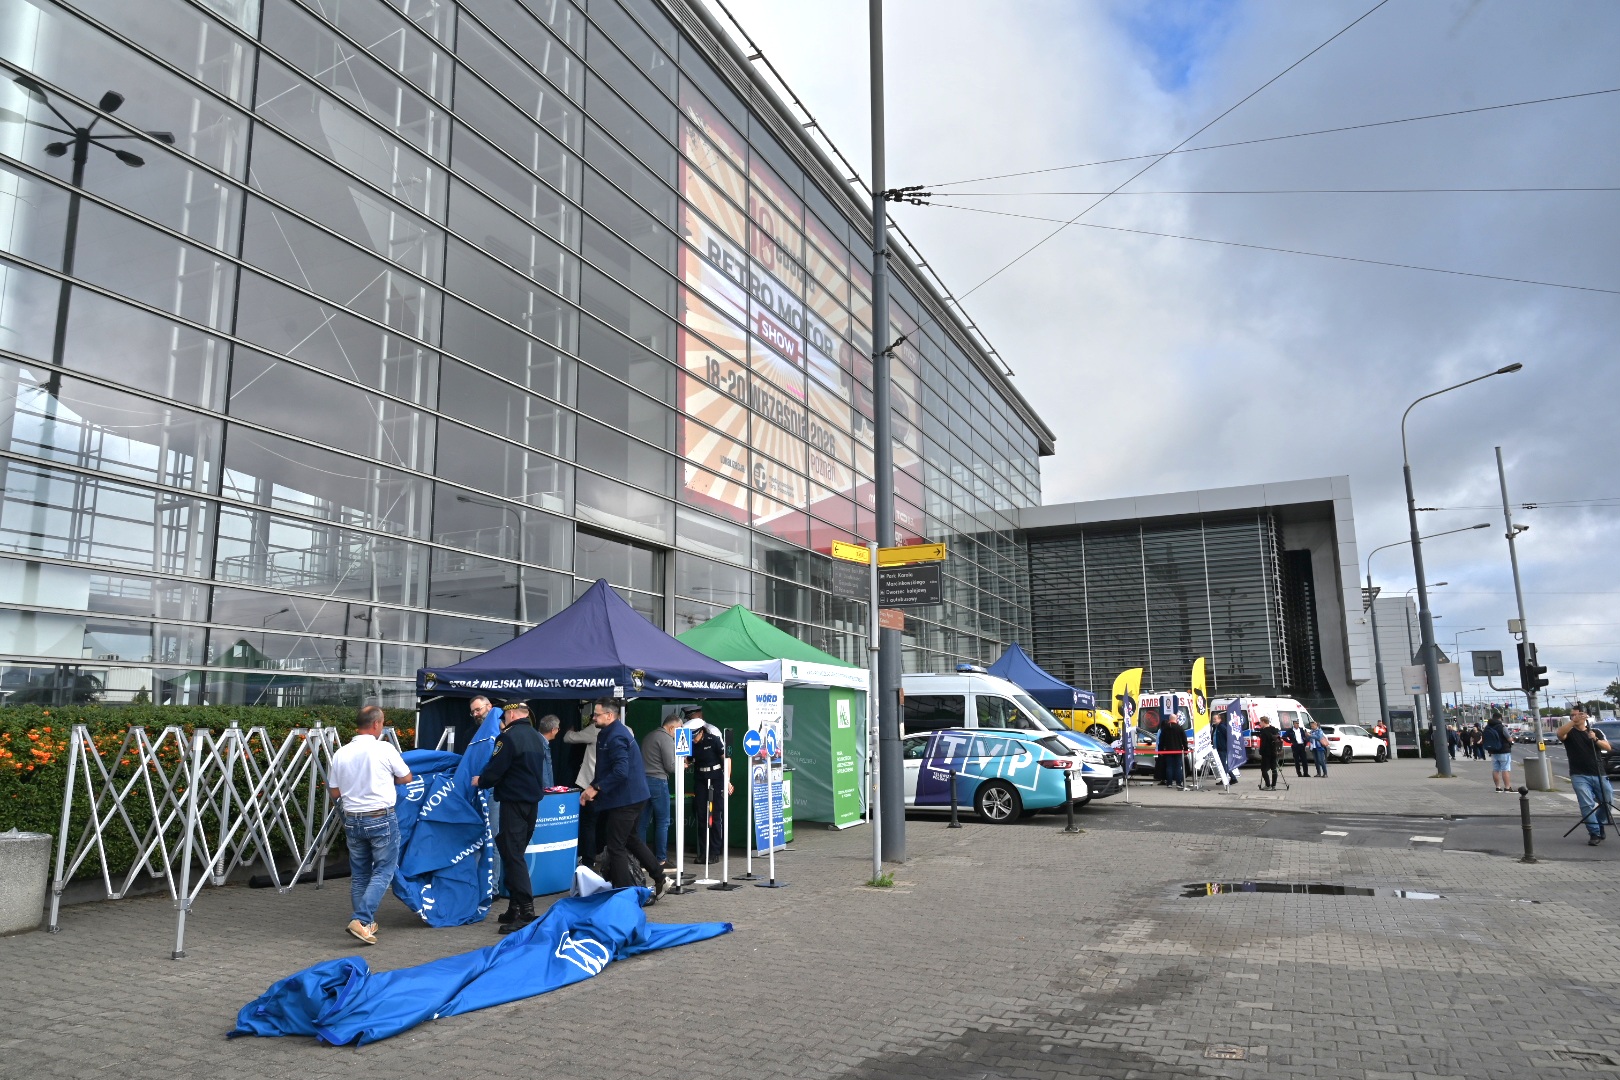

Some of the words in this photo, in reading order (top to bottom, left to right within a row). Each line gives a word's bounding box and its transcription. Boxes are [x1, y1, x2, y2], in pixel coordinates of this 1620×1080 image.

[707, 237, 774, 308] RETRO
[778, 296, 833, 356] MOTOR
[762, 320, 795, 355] SHOW
[705, 356, 746, 404] 18-20
[811, 422, 836, 457] 2026
[449, 679, 480, 689] STRAŻ
[480, 679, 523, 689] MIEJSKA
[525, 678, 562, 688] MIASTA
[563, 677, 616, 688] POZNANIA
[756, 694, 778, 703] WORD
[943, 735, 1033, 777] TVP
